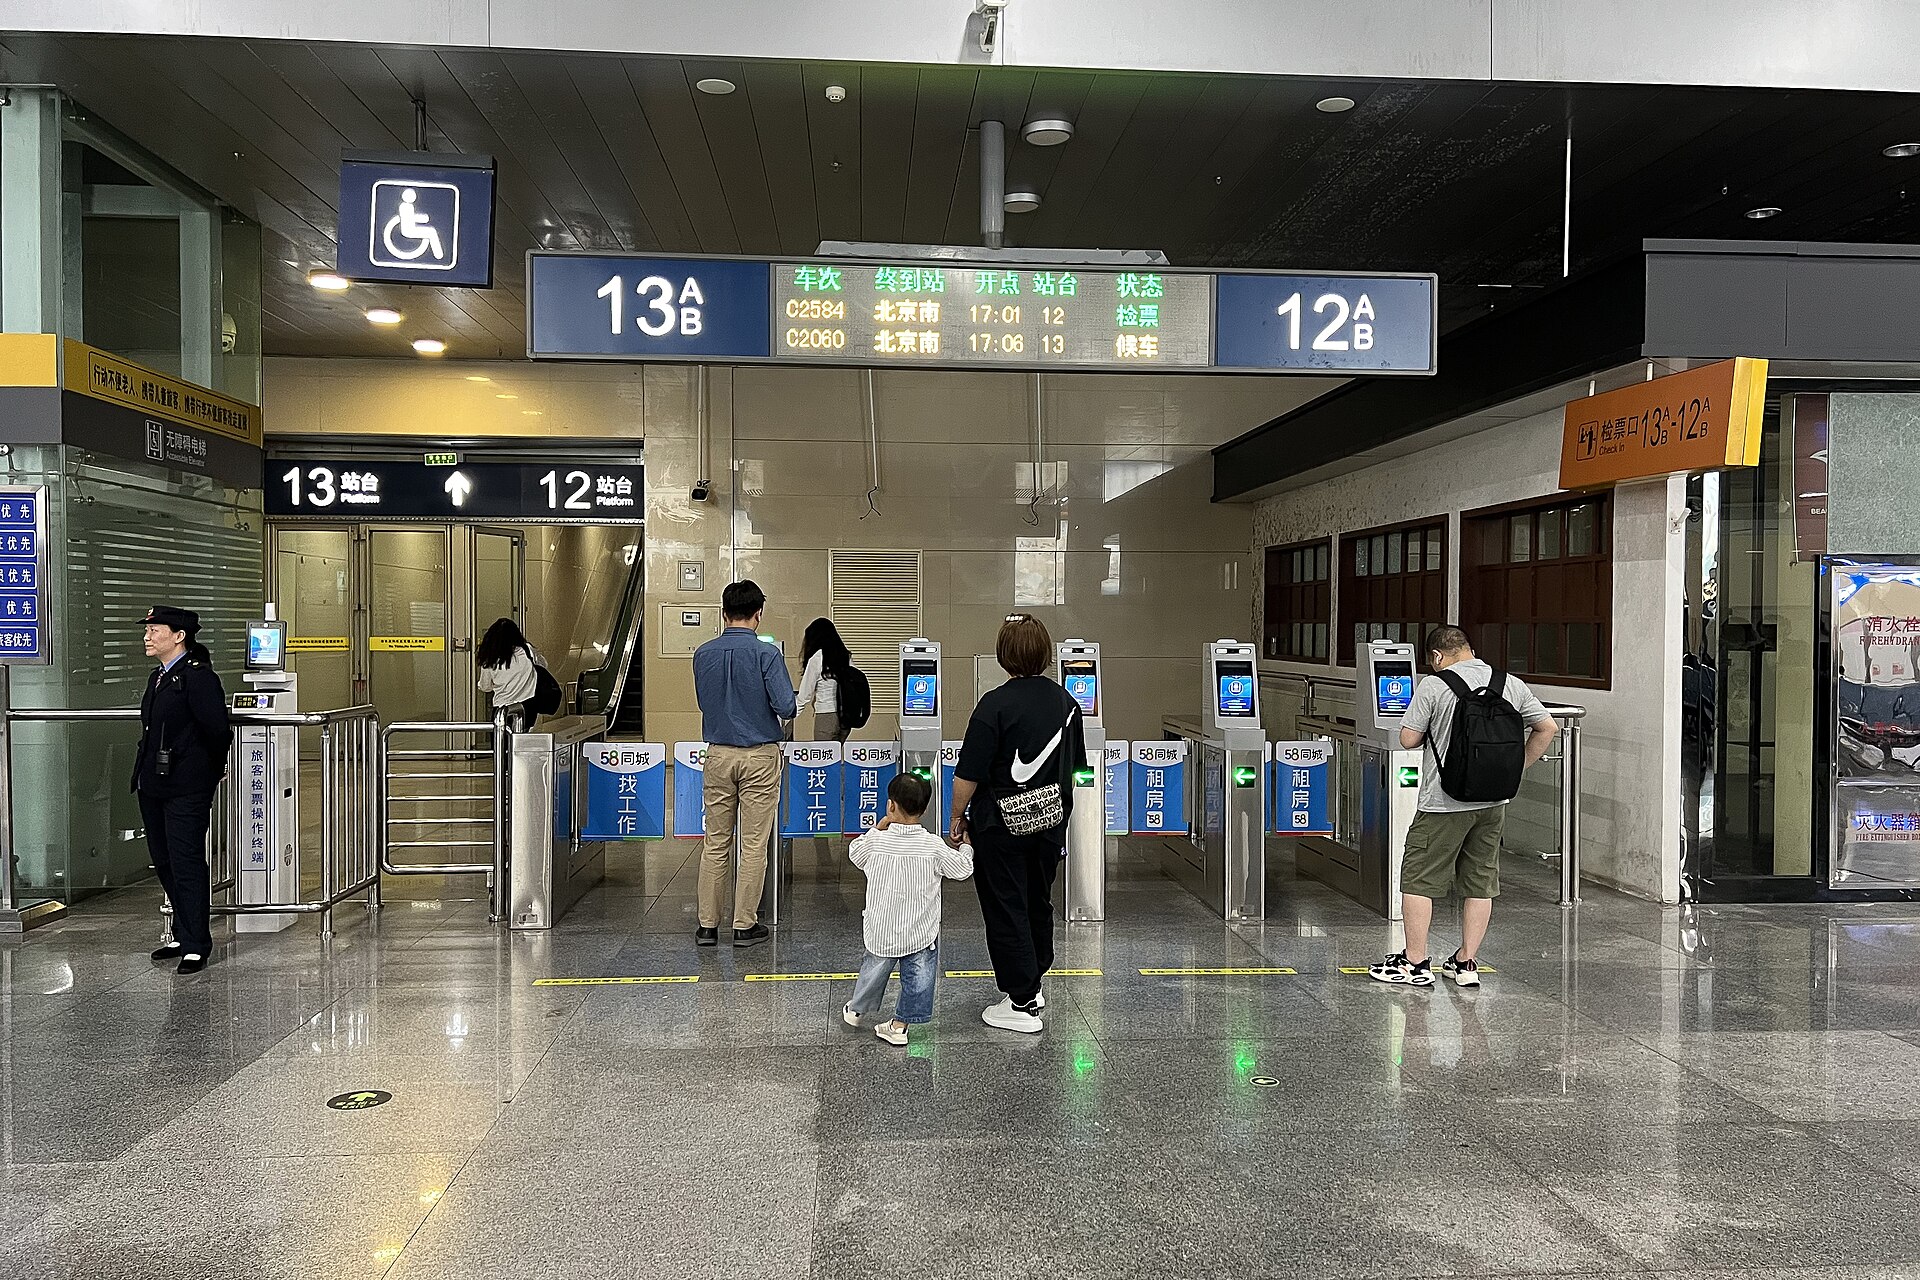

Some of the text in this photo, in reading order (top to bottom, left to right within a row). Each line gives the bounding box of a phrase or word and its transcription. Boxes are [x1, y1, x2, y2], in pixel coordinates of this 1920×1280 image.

[794, 267, 1163, 298] 车次 终到站 开点 站台 状态
[598, 275, 704, 337] 13 A B
[786, 299, 1160, 328] C2584 北京南 17:01 12 检票
[1278, 293, 1376, 351] 12 A B
[786, 328, 1160, 358] C2060 北京南 17:06 13 候车
[1601, 415, 1639, 443] 检票口
[166, 430, 207, 457] 无障碍电梯
[1599, 442, 1617, 456] Check
[282, 466, 336, 507] 13
[341, 471, 379, 492] 站台
[539, 470, 591, 510] 12
[596, 475, 633, 494] 站台
[341, 493, 380, 504] Platform
[596, 496, 634, 507] Platform
[1868, 616, 1920, 633] 消火栓
[600, 750, 650, 767] 58同城
[793, 747, 834, 762] 58同城
[851, 747, 892, 762] 58同城
[1139, 747, 1178, 761] 58同城
[1285, 747, 1323, 761] 58同城
[807, 769, 827, 831] 找工作
[858, 768, 879, 811] 租房
[1145, 769, 1165, 809] 租房
[1291, 769, 1311, 809] 租房
[251, 750, 264, 863] 旅客检票操作终端
[617, 774, 637, 835] 找工作
[862, 815, 875, 826] 58
[1149, 814, 1160, 825] 58
[1294, 814, 1307, 826] 58
[1857, 812, 1920, 831] 灭火器箱
